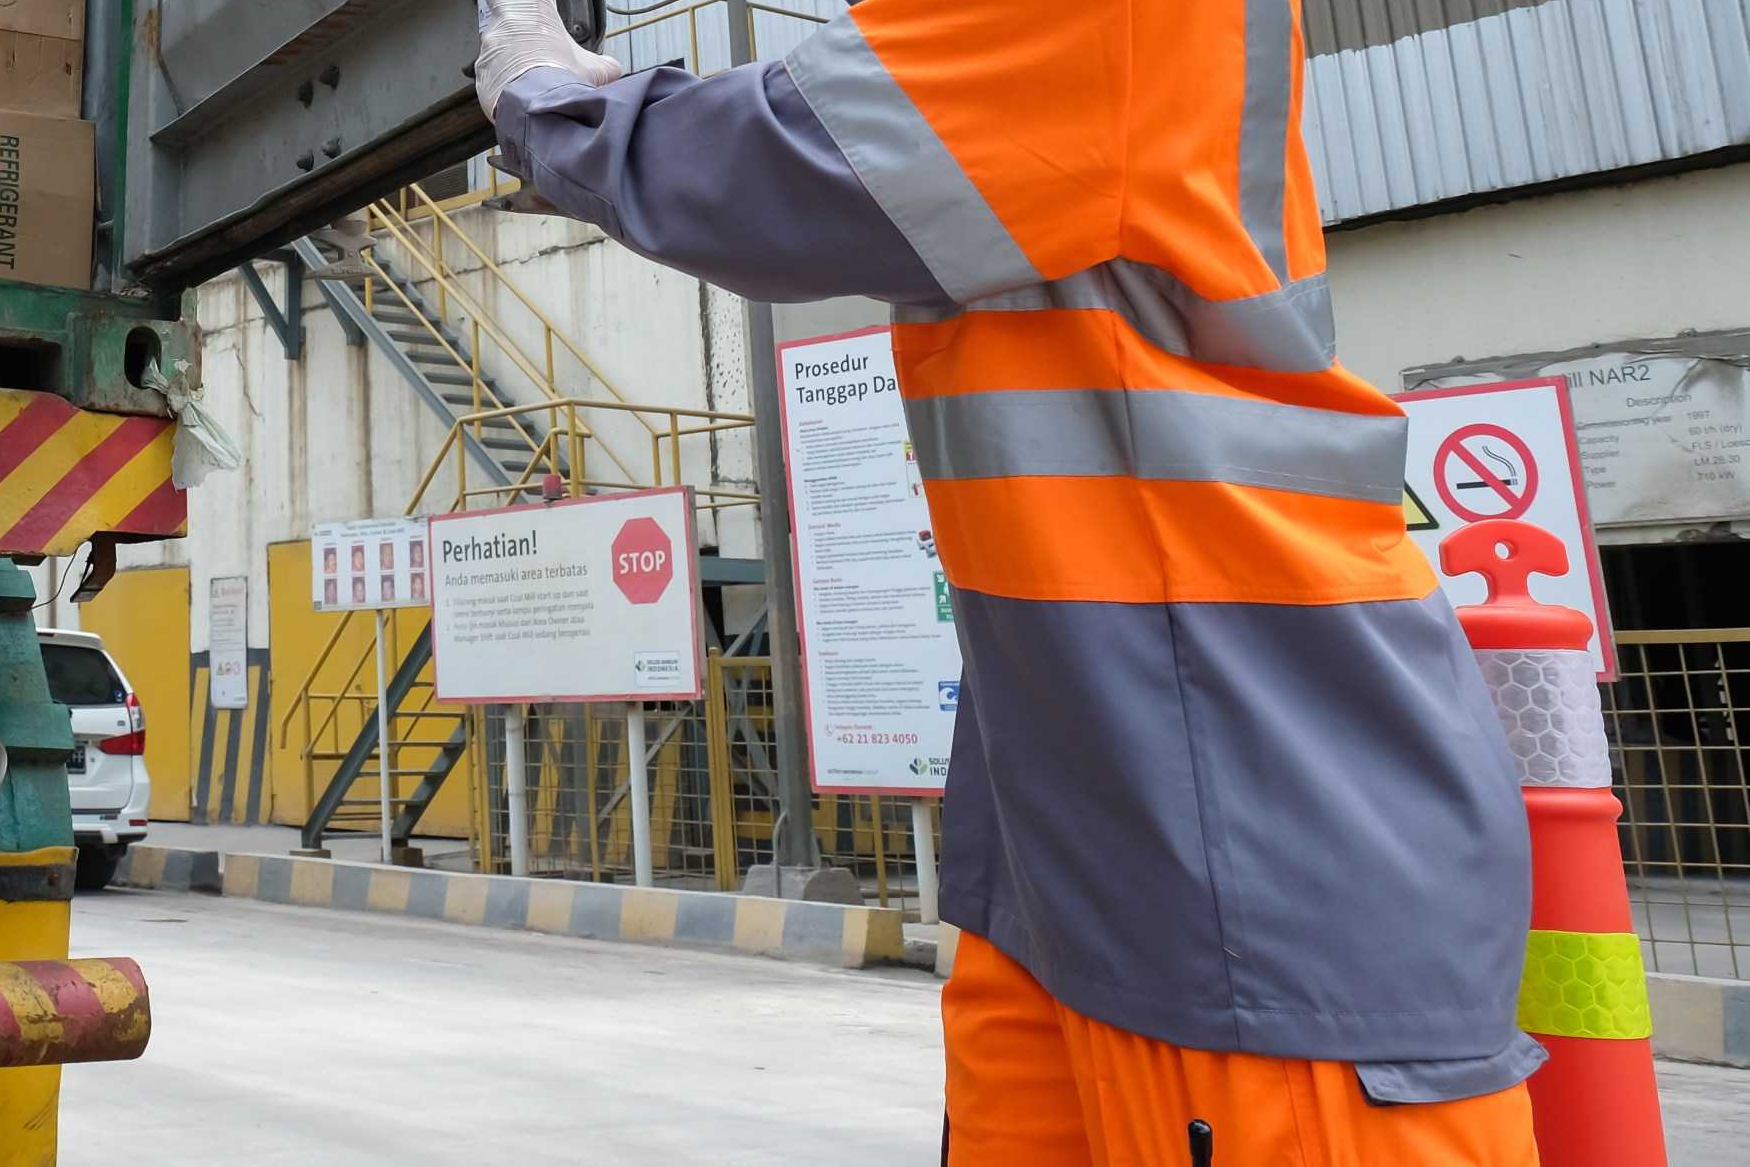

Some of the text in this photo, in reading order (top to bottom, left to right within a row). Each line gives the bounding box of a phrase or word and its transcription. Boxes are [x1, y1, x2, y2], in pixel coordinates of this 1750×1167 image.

[795, 354, 870, 379] Prosedur
[1590, 364, 1652, 386] NAR2
[796, 381, 868, 406] Tanggap
[1626, 394, 1692, 408] Description
[1650, 415, 1672, 427] year
[1579, 434, 1620, 445] Capacity
[1585, 465, 1607, 476] Type
[1586, 480, 1617, 490] Power
[443, 529, 538, 563] Perhatian!
[618, 550, 667, 575] STOP
[445, 563, 589, 587] Anda memasuki area terbatas
[837, 733, 918, 744] +62 21 823 4050
